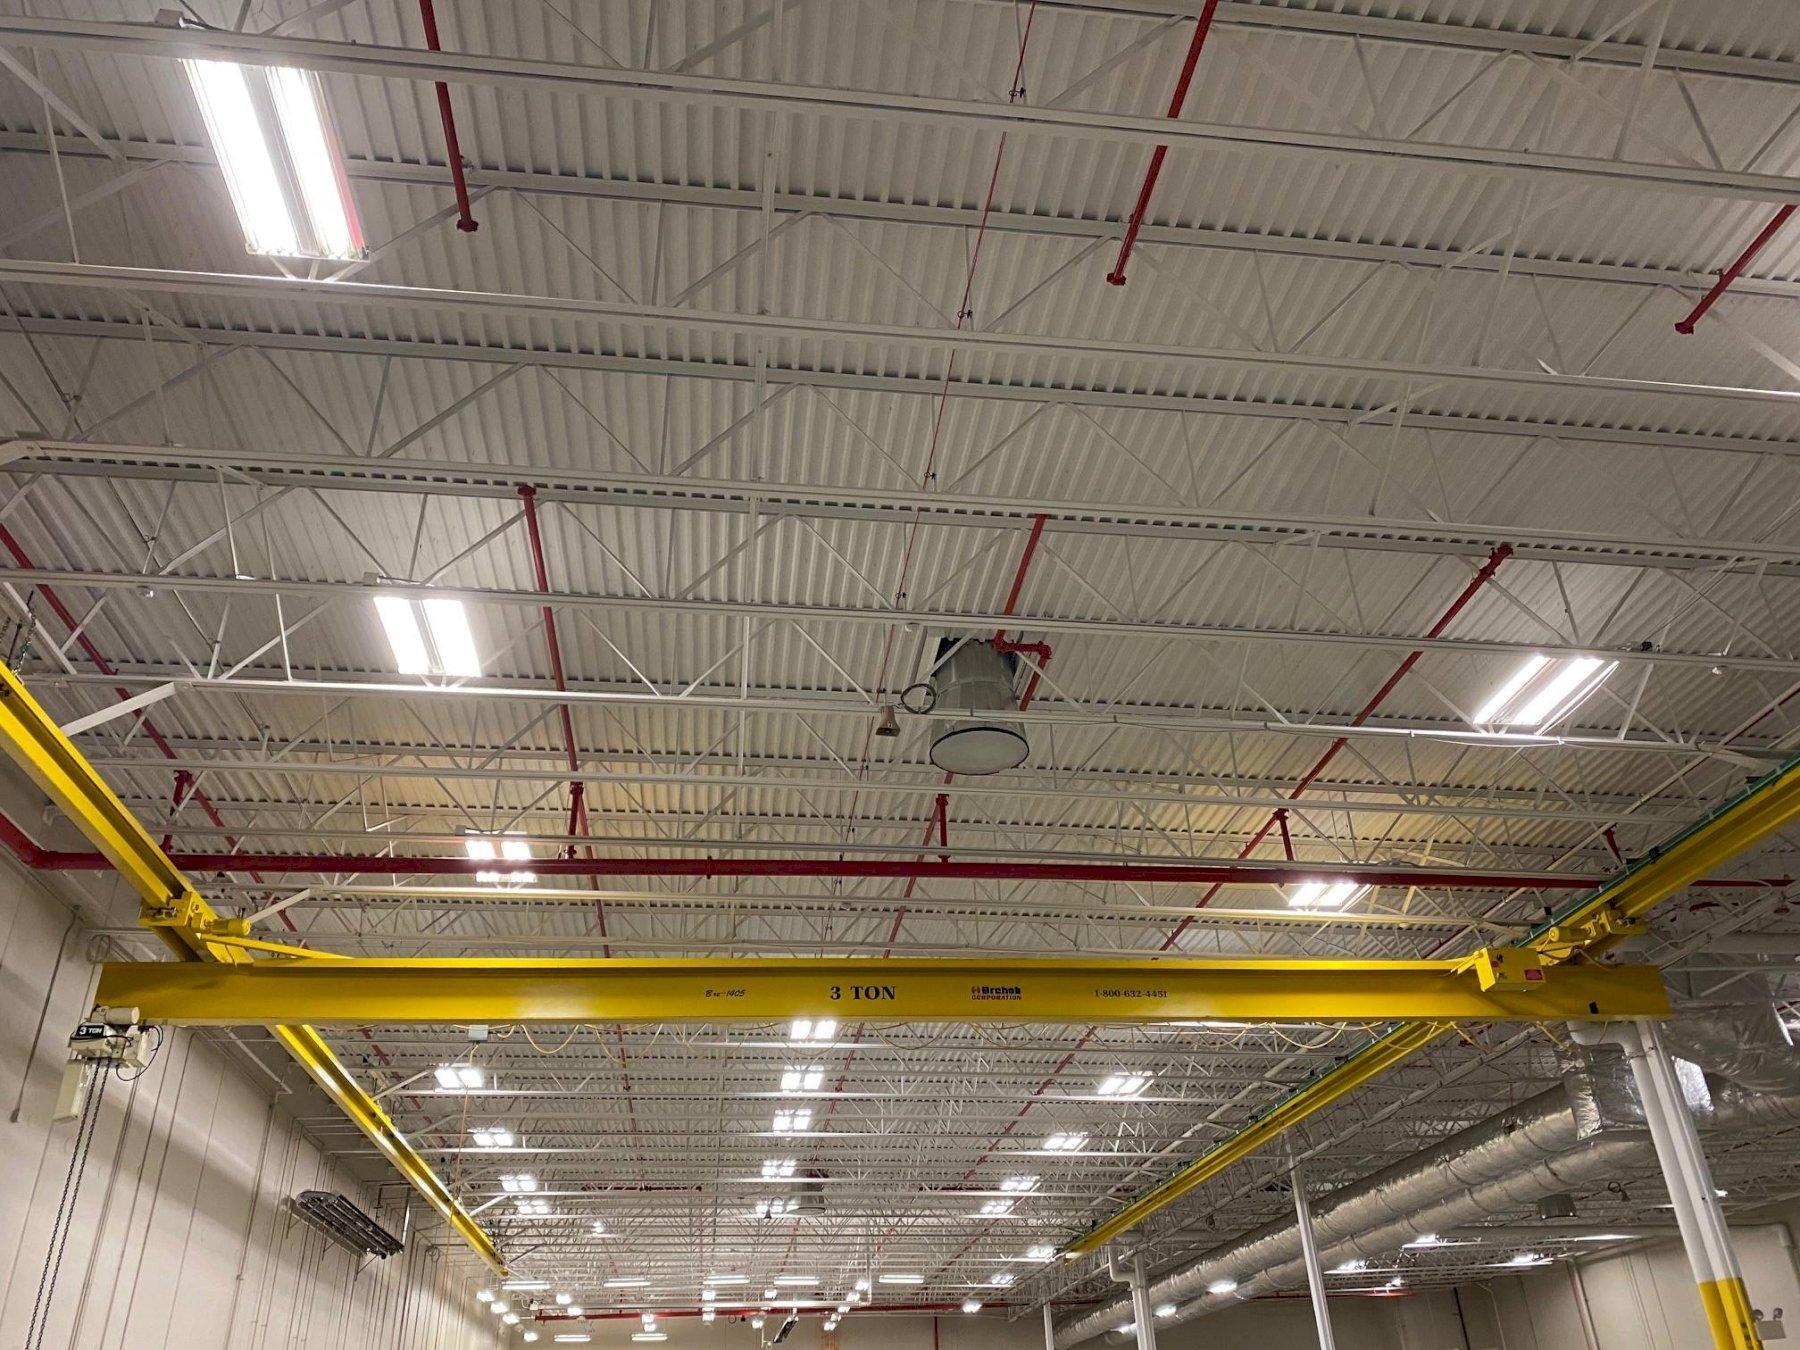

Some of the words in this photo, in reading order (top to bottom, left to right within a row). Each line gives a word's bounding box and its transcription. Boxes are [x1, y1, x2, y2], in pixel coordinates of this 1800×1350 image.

[830, 986, 842, 1000] 3
[851, 986, 897, 1000] TON
[1095, 989, 1168, 998] 1-800-632-4451
[79, 1026, 87, 1035] 3
